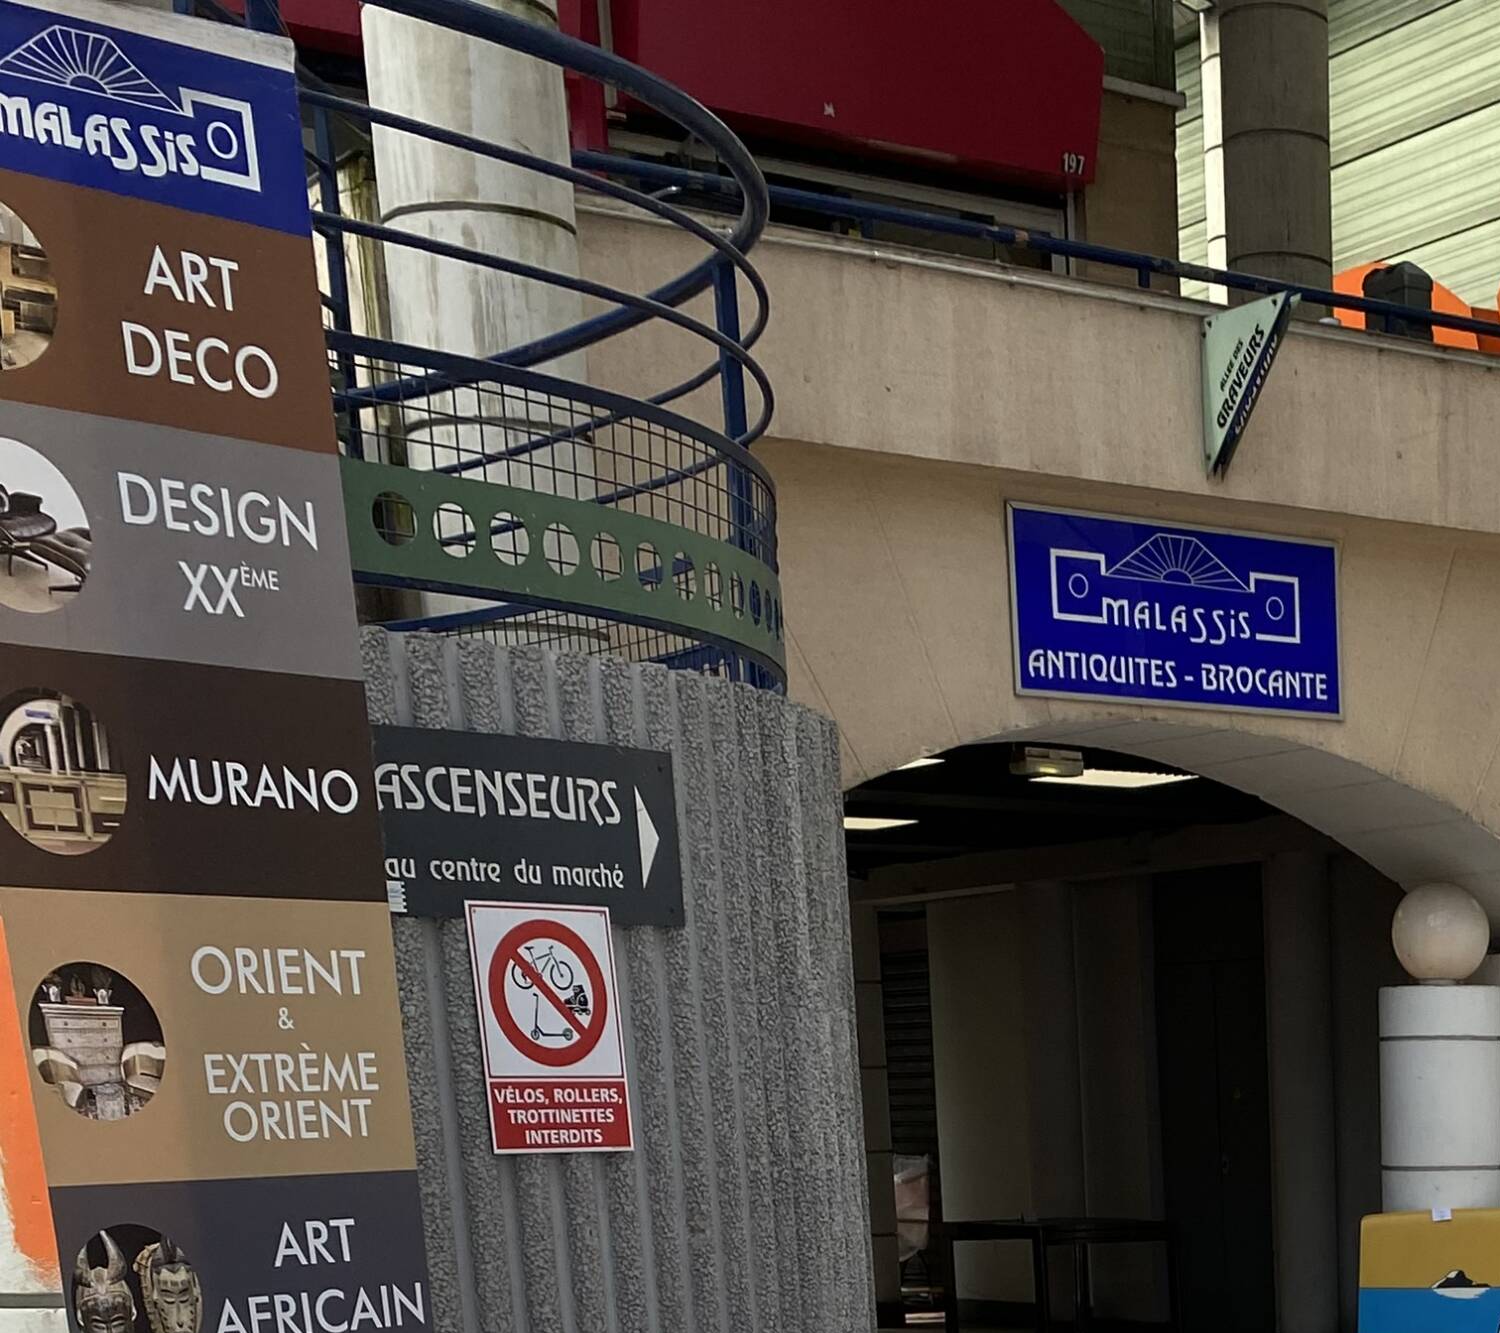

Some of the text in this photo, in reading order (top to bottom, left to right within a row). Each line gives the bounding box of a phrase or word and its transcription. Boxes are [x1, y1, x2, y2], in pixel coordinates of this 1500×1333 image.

[1062, 152, 1085, 175] 197
[144, 244, 239, 311] ART
[121, 321, 279, 399] DECO
[1216, 323, 1265, 429] GRAVEURS
[117, 471, 318, 551] DESIGN
[1028, 648, 1177, 688] ANTIQUITES
[1201, 663, 1328, 700] BROCANTE
[148, 755, 359, 814] MURANO
[374, 762, 621, 827] ASCENSEURS
[384, 857, 625, 889] au centre du marché
[191, 946, 366, 996] ORIENT
[278, 1006, 295, 1030] &
[204, 1042, 380, 1094] EXTRÈME
[223, 1098, 372, 1142] ORIENT
[494, 1085, 623, 1105] VÉLOS, ROLLERS,
[507, 1108, 615, 1125] TROTTINETTES
[525, 1129, 603, 1145] INTERDITS
[274, 1218, 356, 1268] ART
